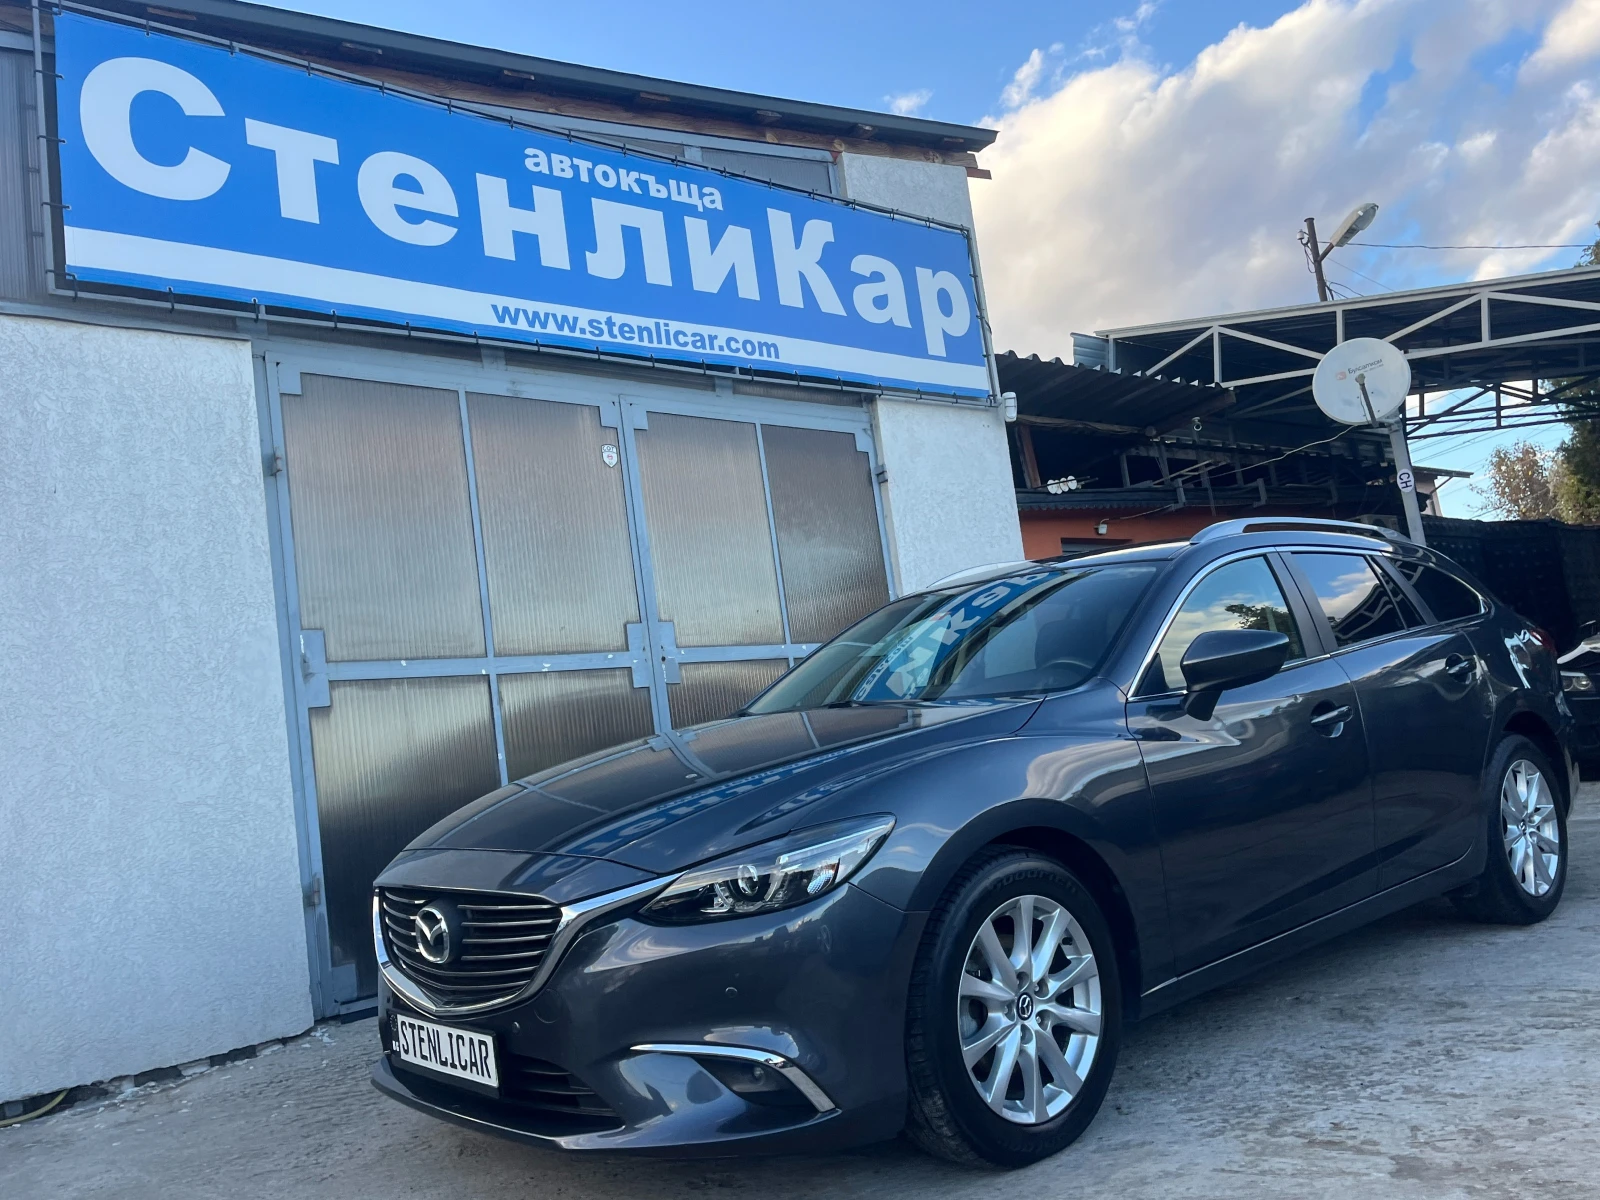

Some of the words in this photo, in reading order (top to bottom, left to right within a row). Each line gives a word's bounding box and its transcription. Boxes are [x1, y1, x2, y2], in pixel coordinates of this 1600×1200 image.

[80, 56, 971, 358] СтенлиКар
[524, 147, 724, 212] автокъща
[490, 303, 780, 360] www.stenlicar.com
[1399, 472, 1412, 489] CH
[401, 1020, 492, 1079] STENLICAR
